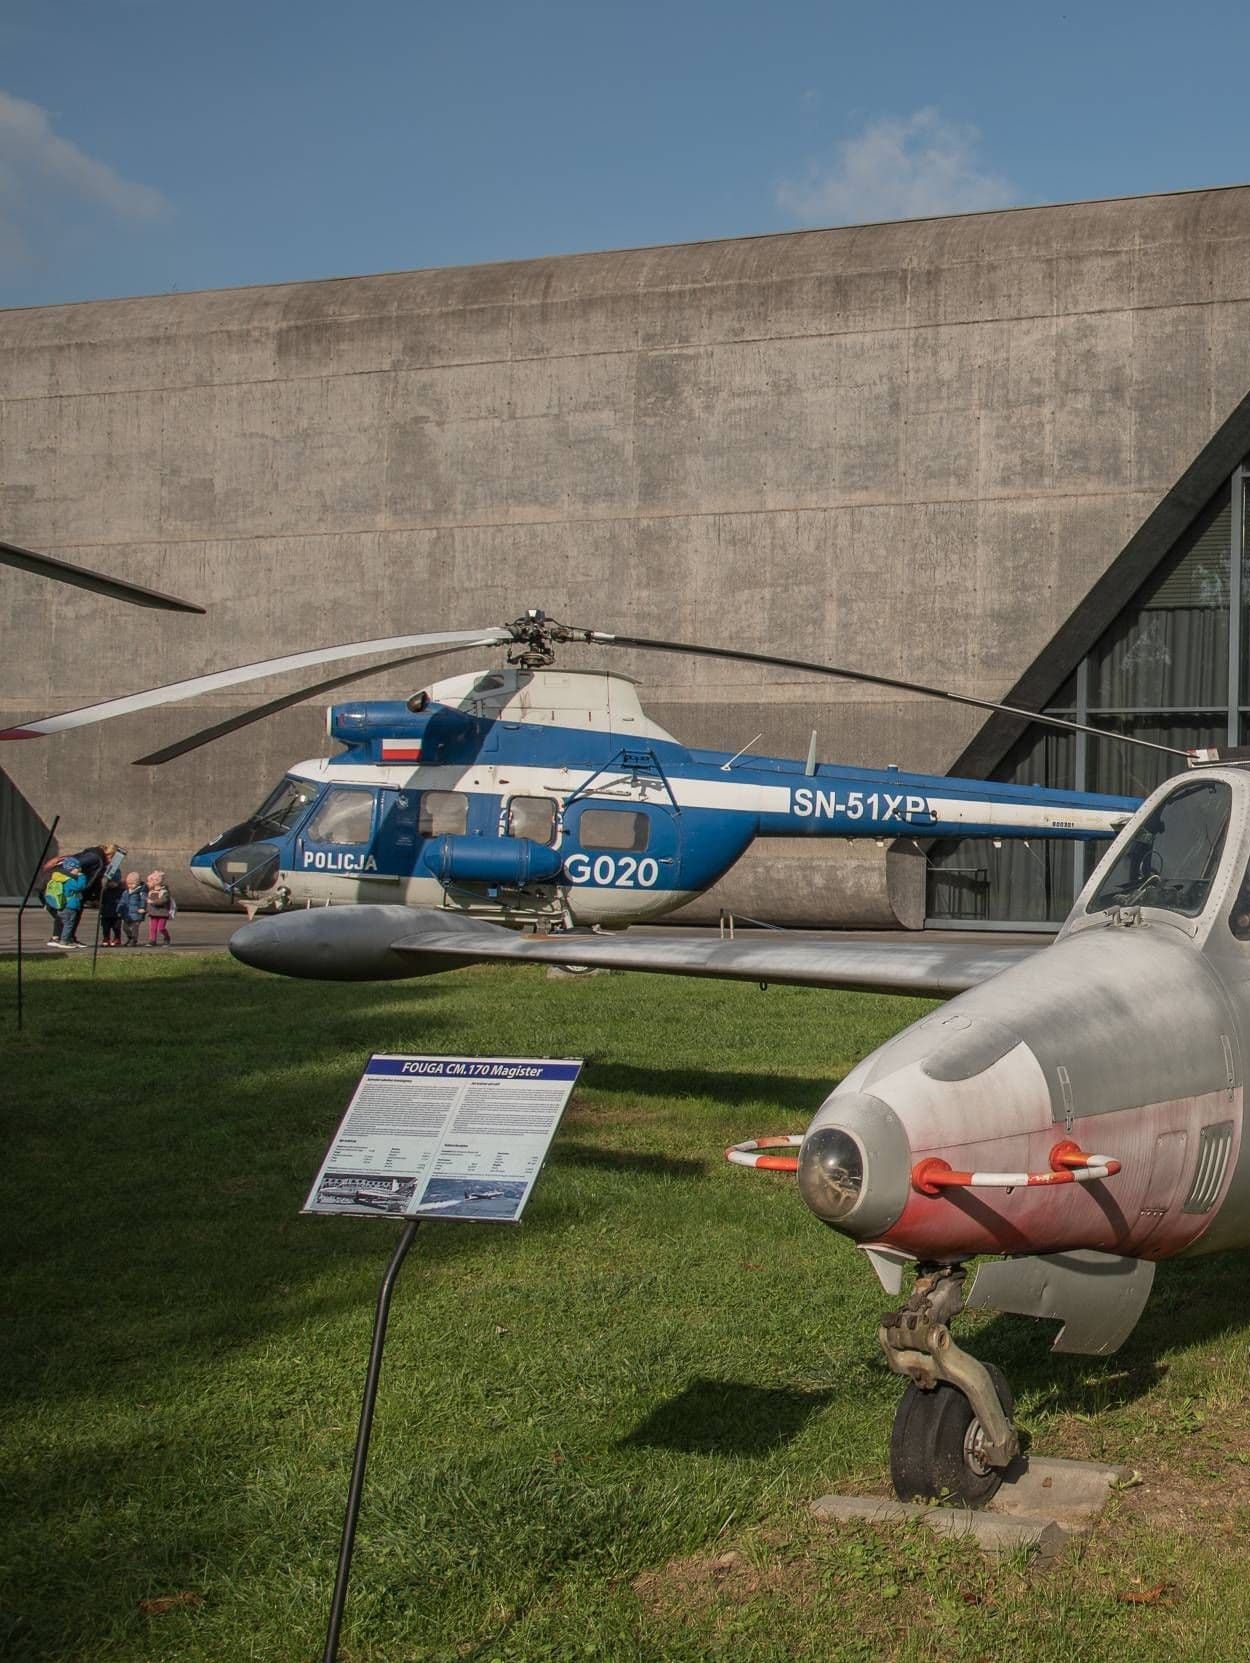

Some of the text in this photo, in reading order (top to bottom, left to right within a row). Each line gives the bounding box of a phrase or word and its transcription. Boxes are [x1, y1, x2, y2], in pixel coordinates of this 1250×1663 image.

[793, 788, 926, 823] SN-51XP
[303, 850, 378, 871] POLICJA
[563, 853, 659, 887] G020
[401, 1062, 543, 1079] FOUGA CM.170 Magister
